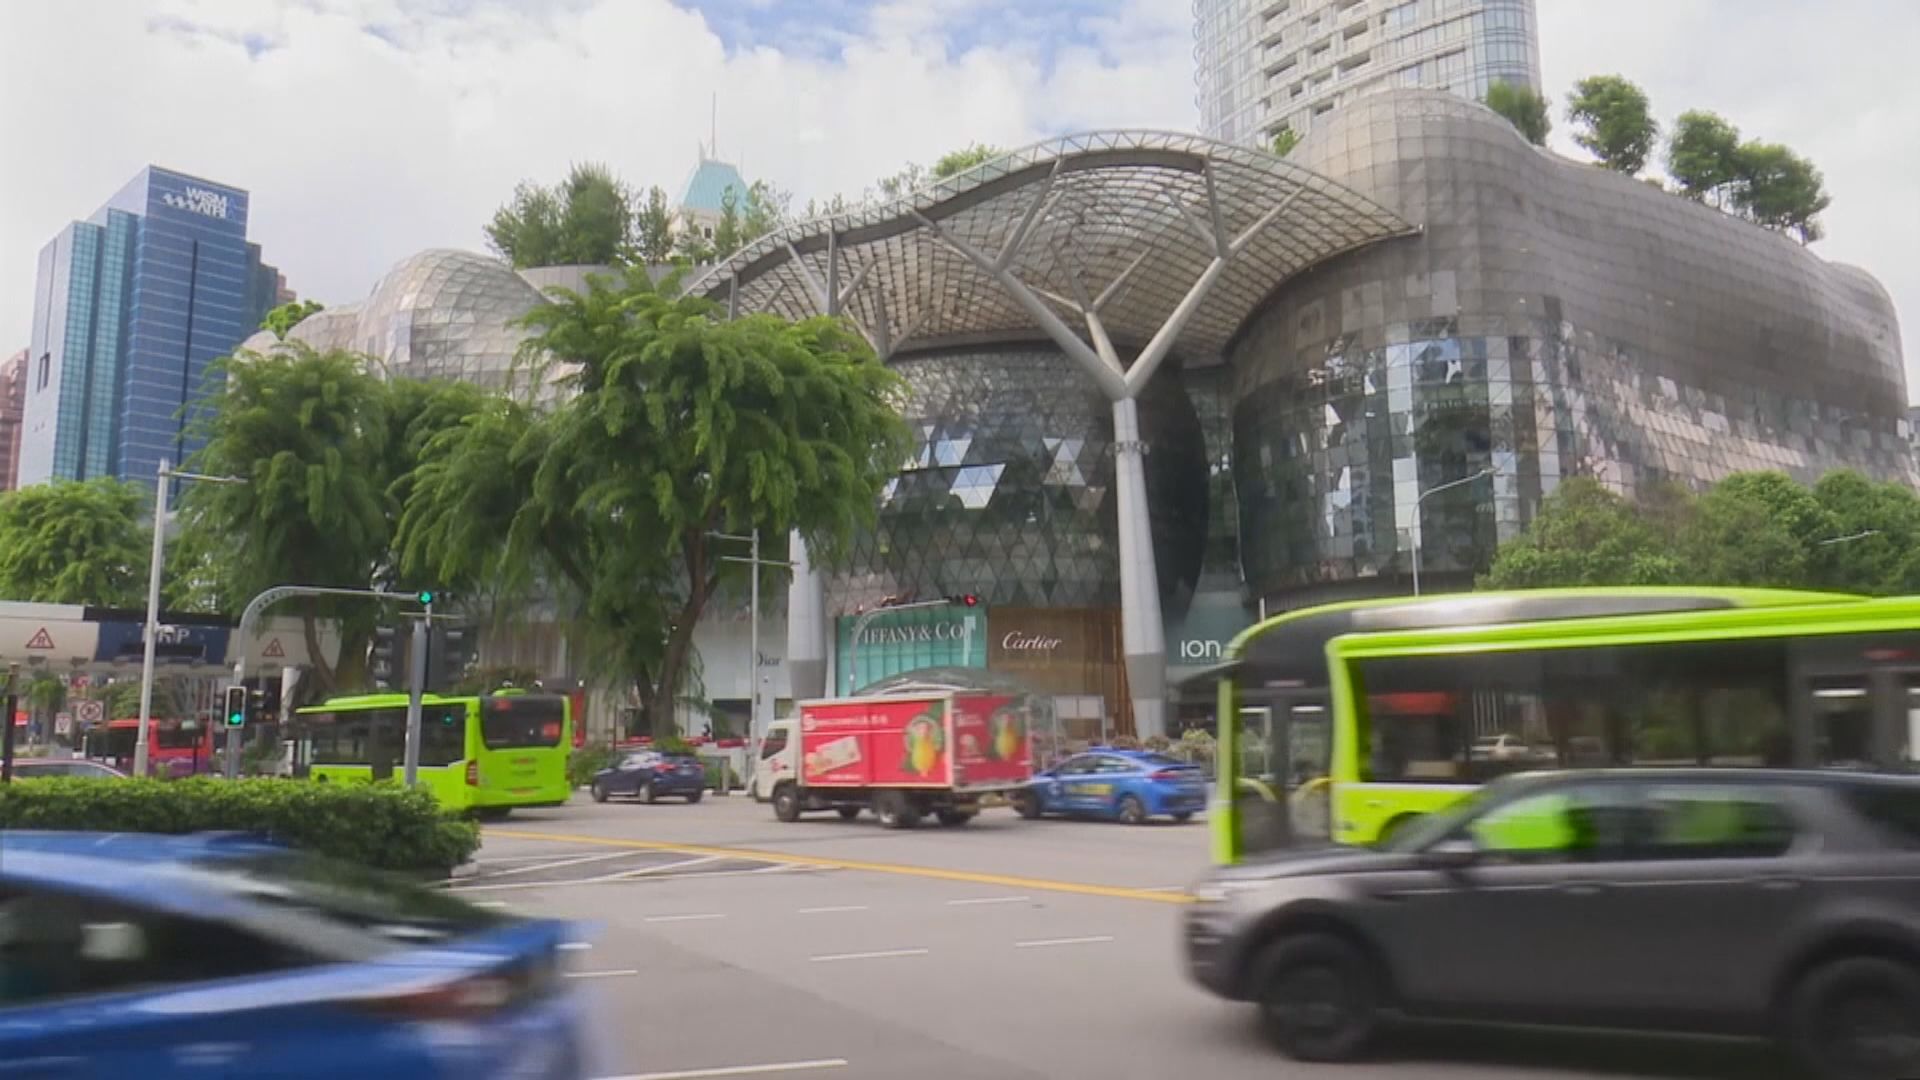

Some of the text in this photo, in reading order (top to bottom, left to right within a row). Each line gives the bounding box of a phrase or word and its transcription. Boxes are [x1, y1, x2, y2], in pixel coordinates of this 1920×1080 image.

[861, 625, 916, 644] IFFANY
[919, 624, 932, 641] &
[1002, 630, 1062, 648] Cartier
